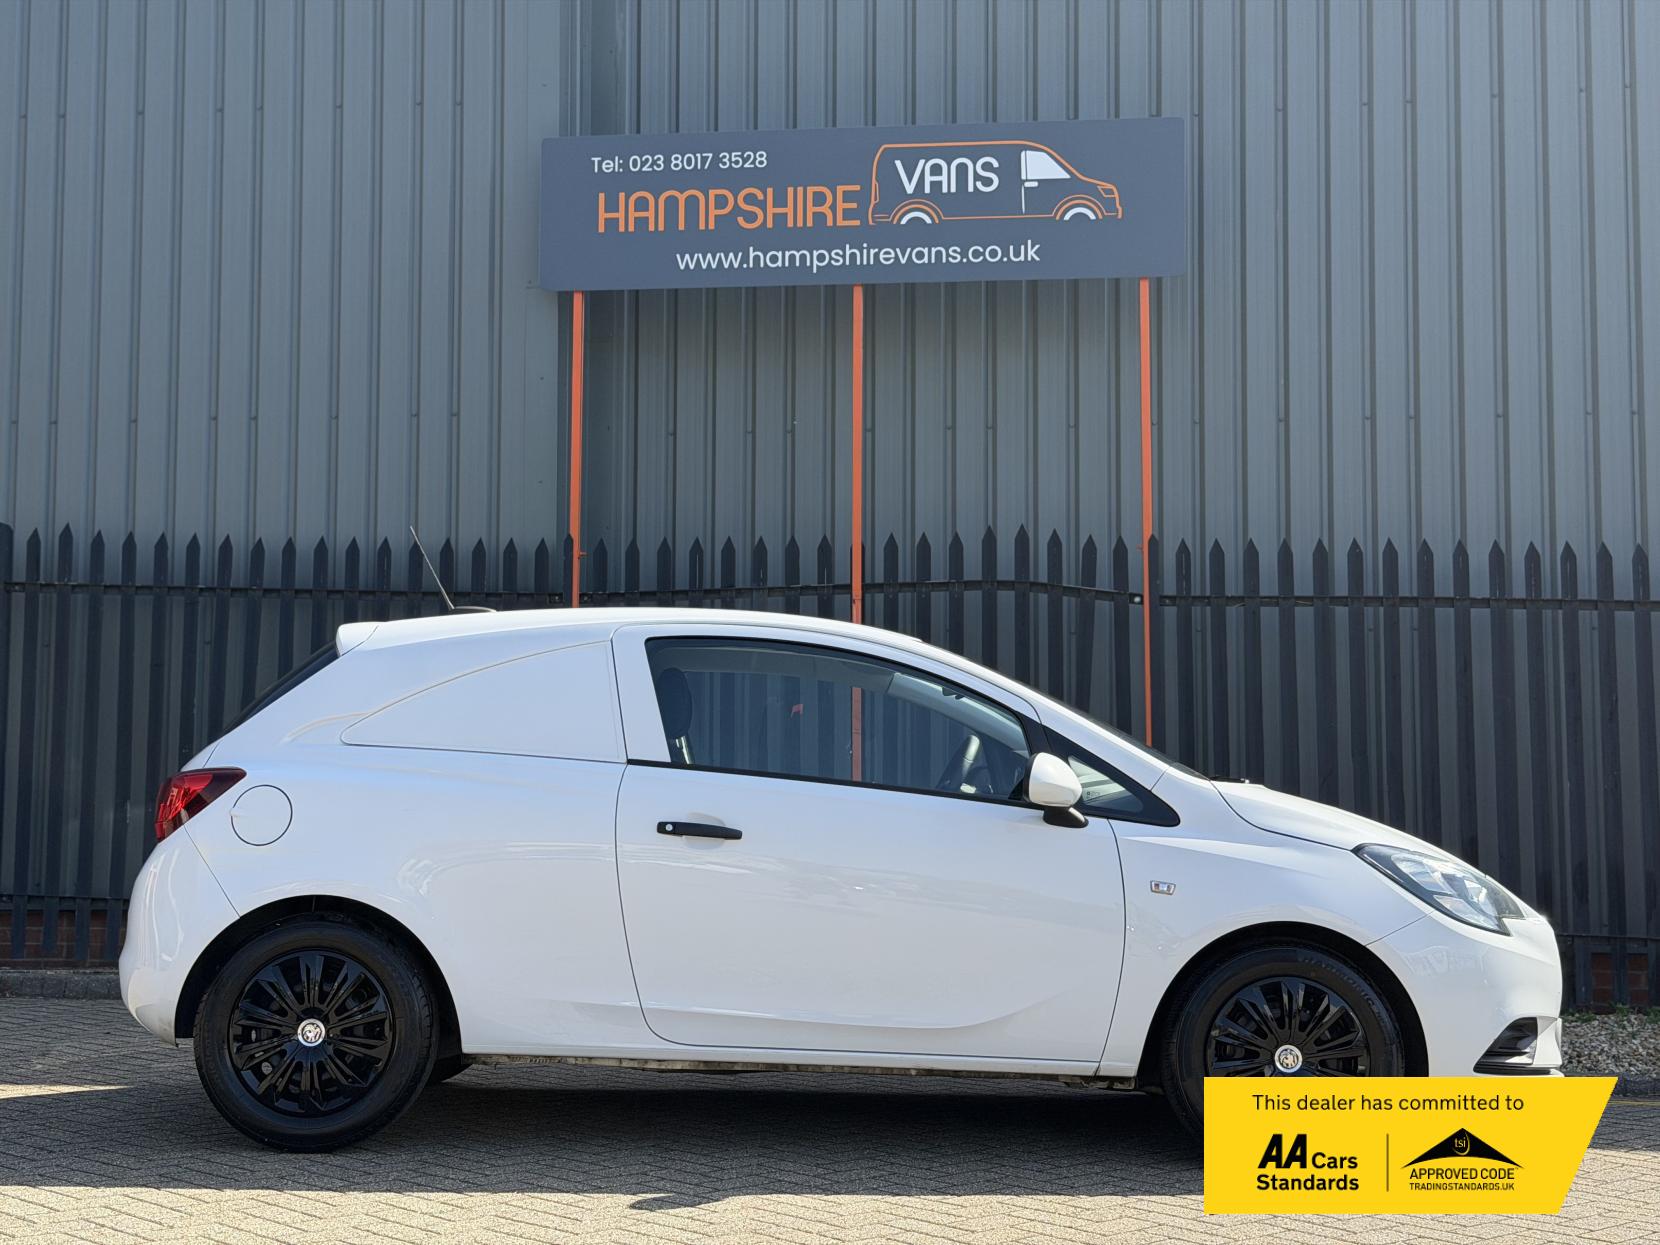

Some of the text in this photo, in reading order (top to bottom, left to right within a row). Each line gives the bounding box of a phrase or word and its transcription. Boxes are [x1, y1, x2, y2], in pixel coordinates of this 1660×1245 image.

[590, 151, 768, 173] Tel: 023 8017 3528
[598, 157, 1000, 233] HAMPSHIRE VANS
[675, 240, 1041, 274] www.hampshirevans.co.uk
